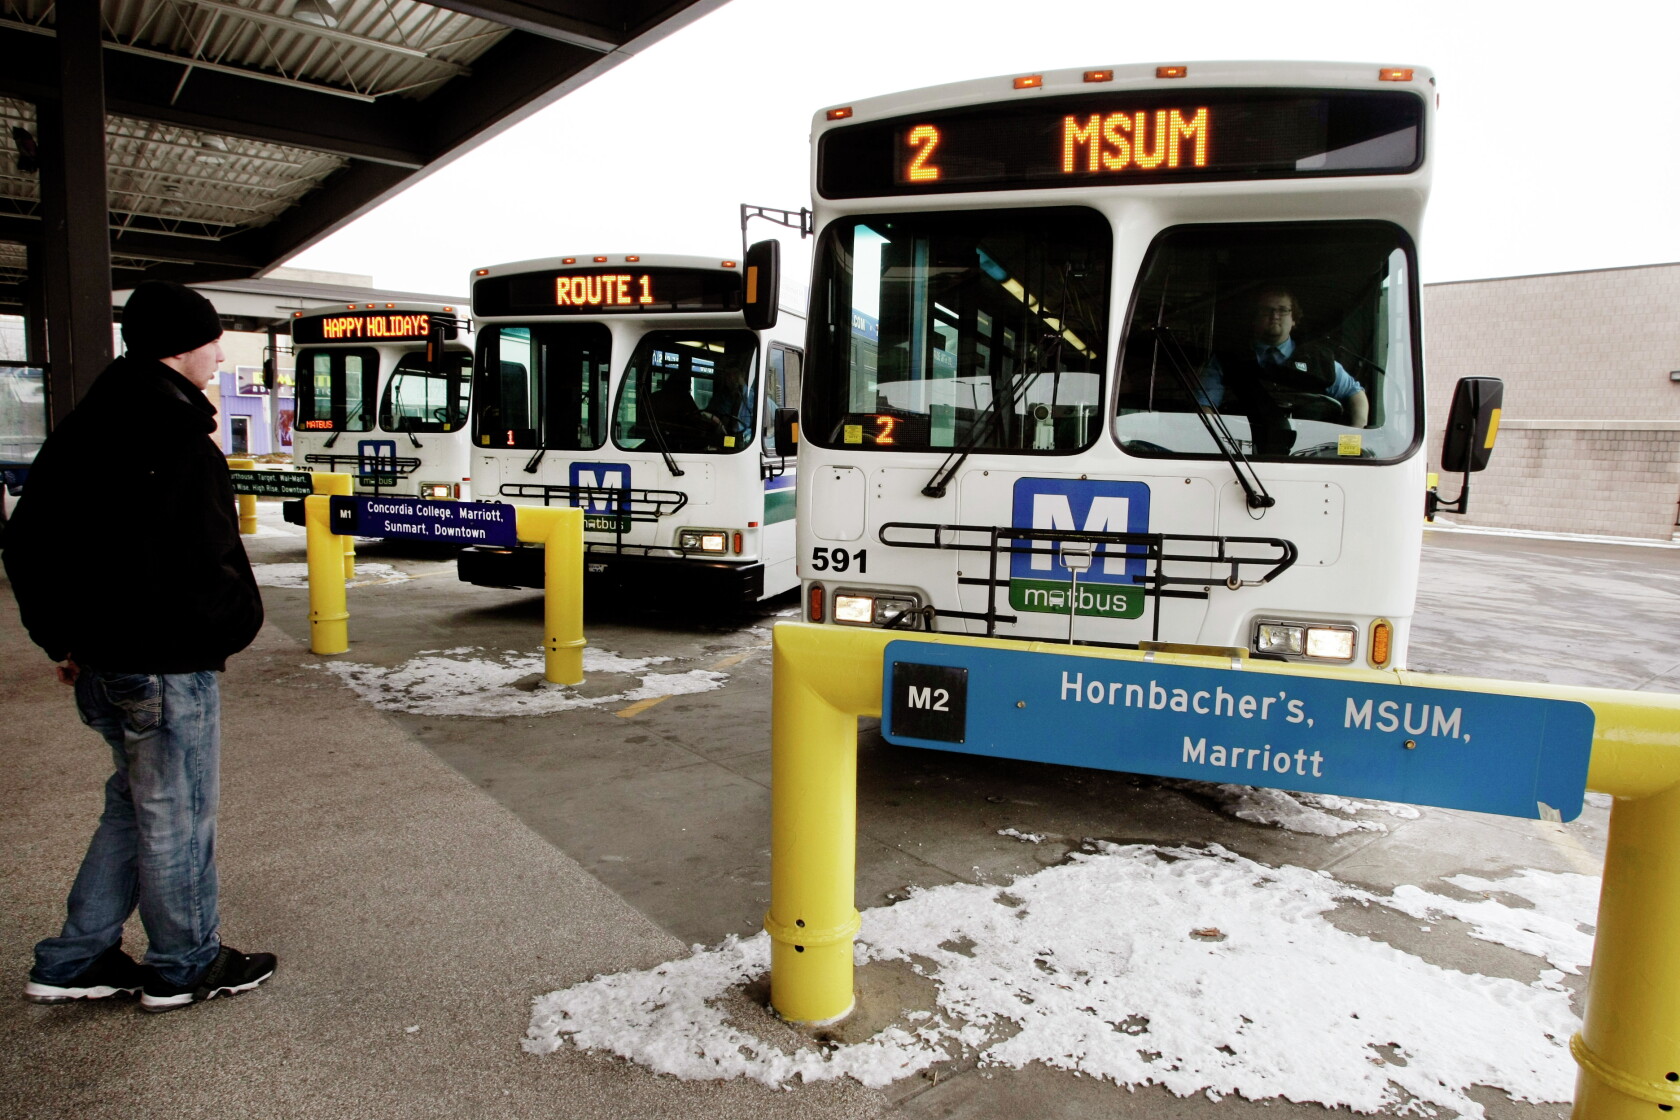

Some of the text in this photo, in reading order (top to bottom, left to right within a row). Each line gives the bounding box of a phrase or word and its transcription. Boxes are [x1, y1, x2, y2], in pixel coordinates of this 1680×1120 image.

[907, 107, 1209, 182] 2 MSUM
[556, 275, 653, 305] ROUTE 1
[323, 315, 430, 338] HAPPY HOLIDAYS
[306, 420, 333, 429] MATBUS
[507, 430, 514, 445] 1
[876, 416, 894, 443] 2
[281, 486, 311, 494] Downtown
[578, 470, 622, 511] M
[339, 509, 352, 519] M1
[367, 501, 504, 523] Concordia College, Marriott,
[384, 520, 486, 539] Sunmart, Downtown
[1030, 493, 1130, 576] M
[811, 547, 867, 573] 591
[908, 685, 949, 712] M2
[1060, 671, 1471, 744] Hornbacher's, MSUM,
[1182, 736, 1324, 778] Marriott
